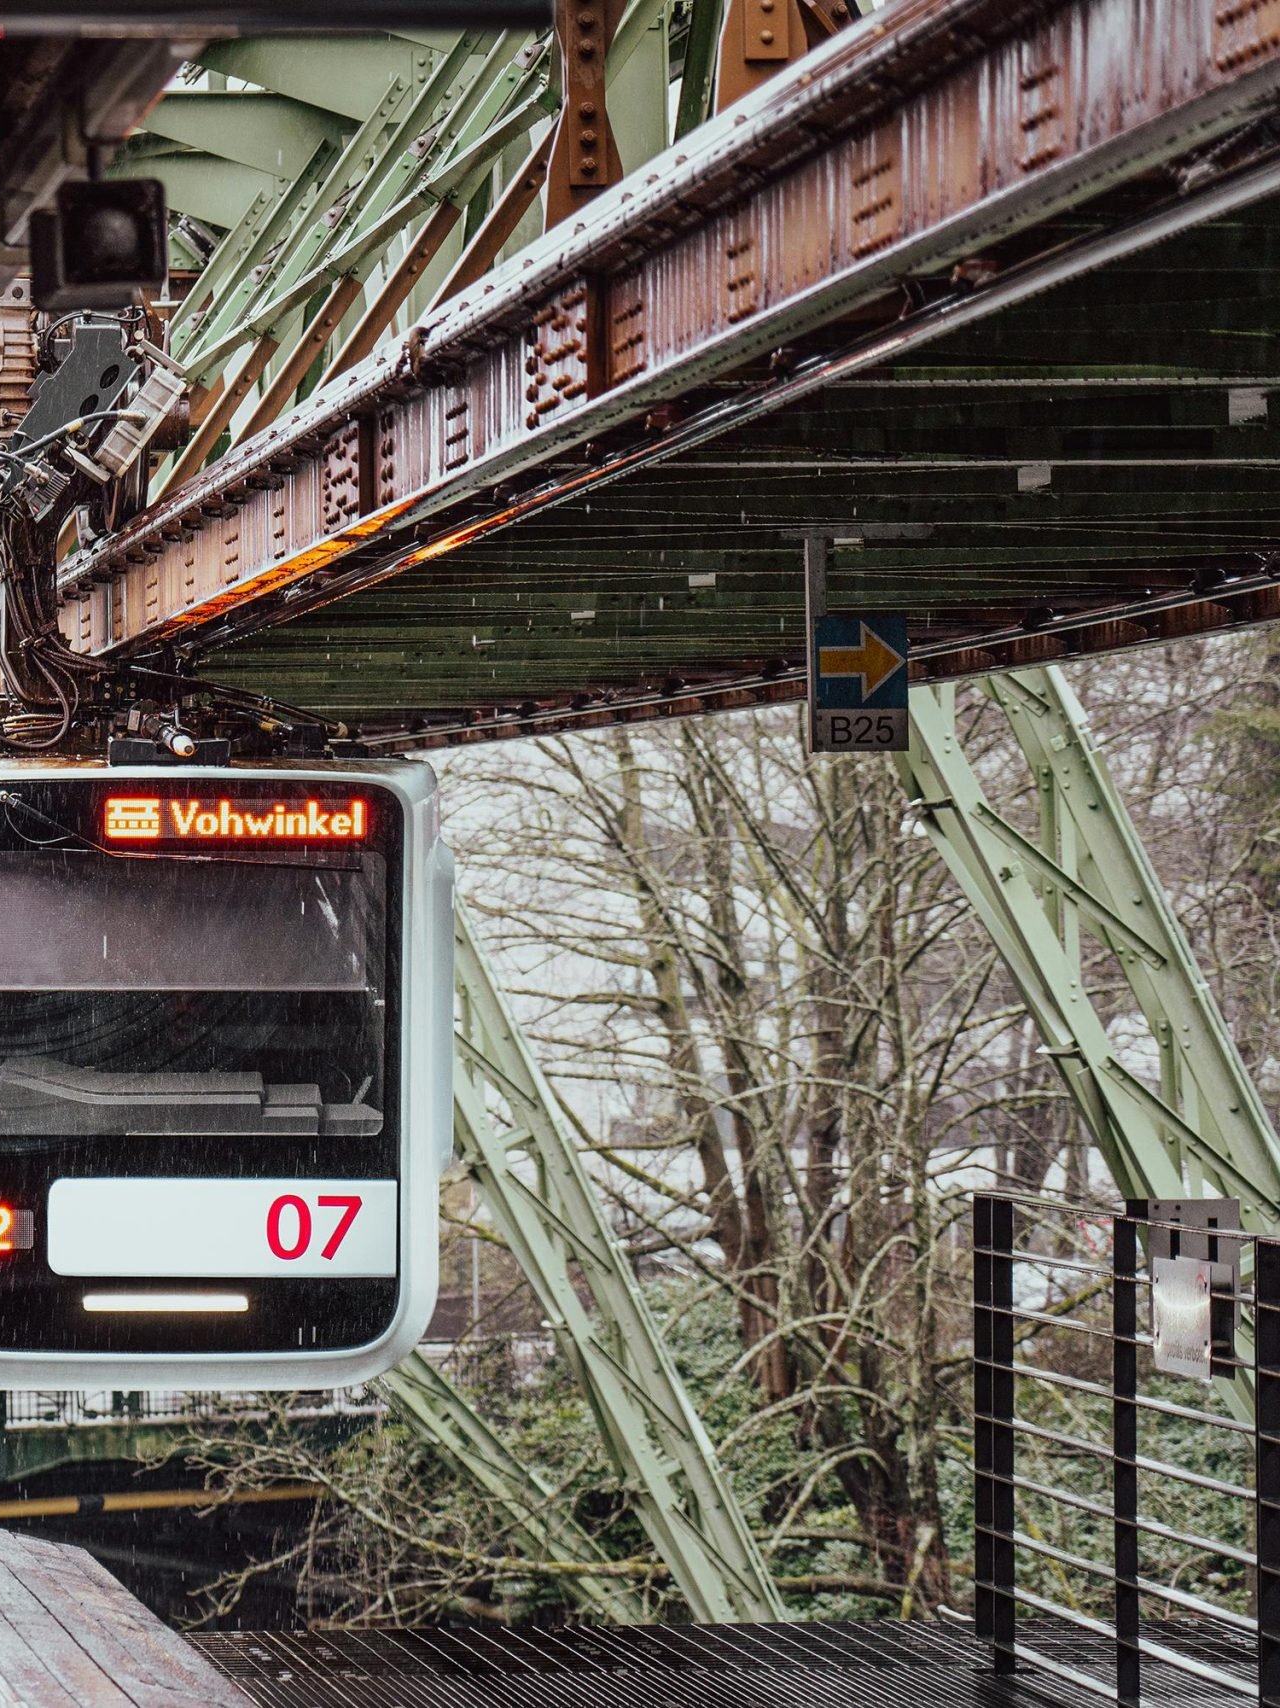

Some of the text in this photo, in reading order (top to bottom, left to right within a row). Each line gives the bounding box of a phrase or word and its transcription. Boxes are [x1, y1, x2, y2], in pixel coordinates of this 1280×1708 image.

[830, 715, 895, 745] B25
[169, 799, 365, 837] Vohwinkel
[265, 1194, 364, 1261] 07
